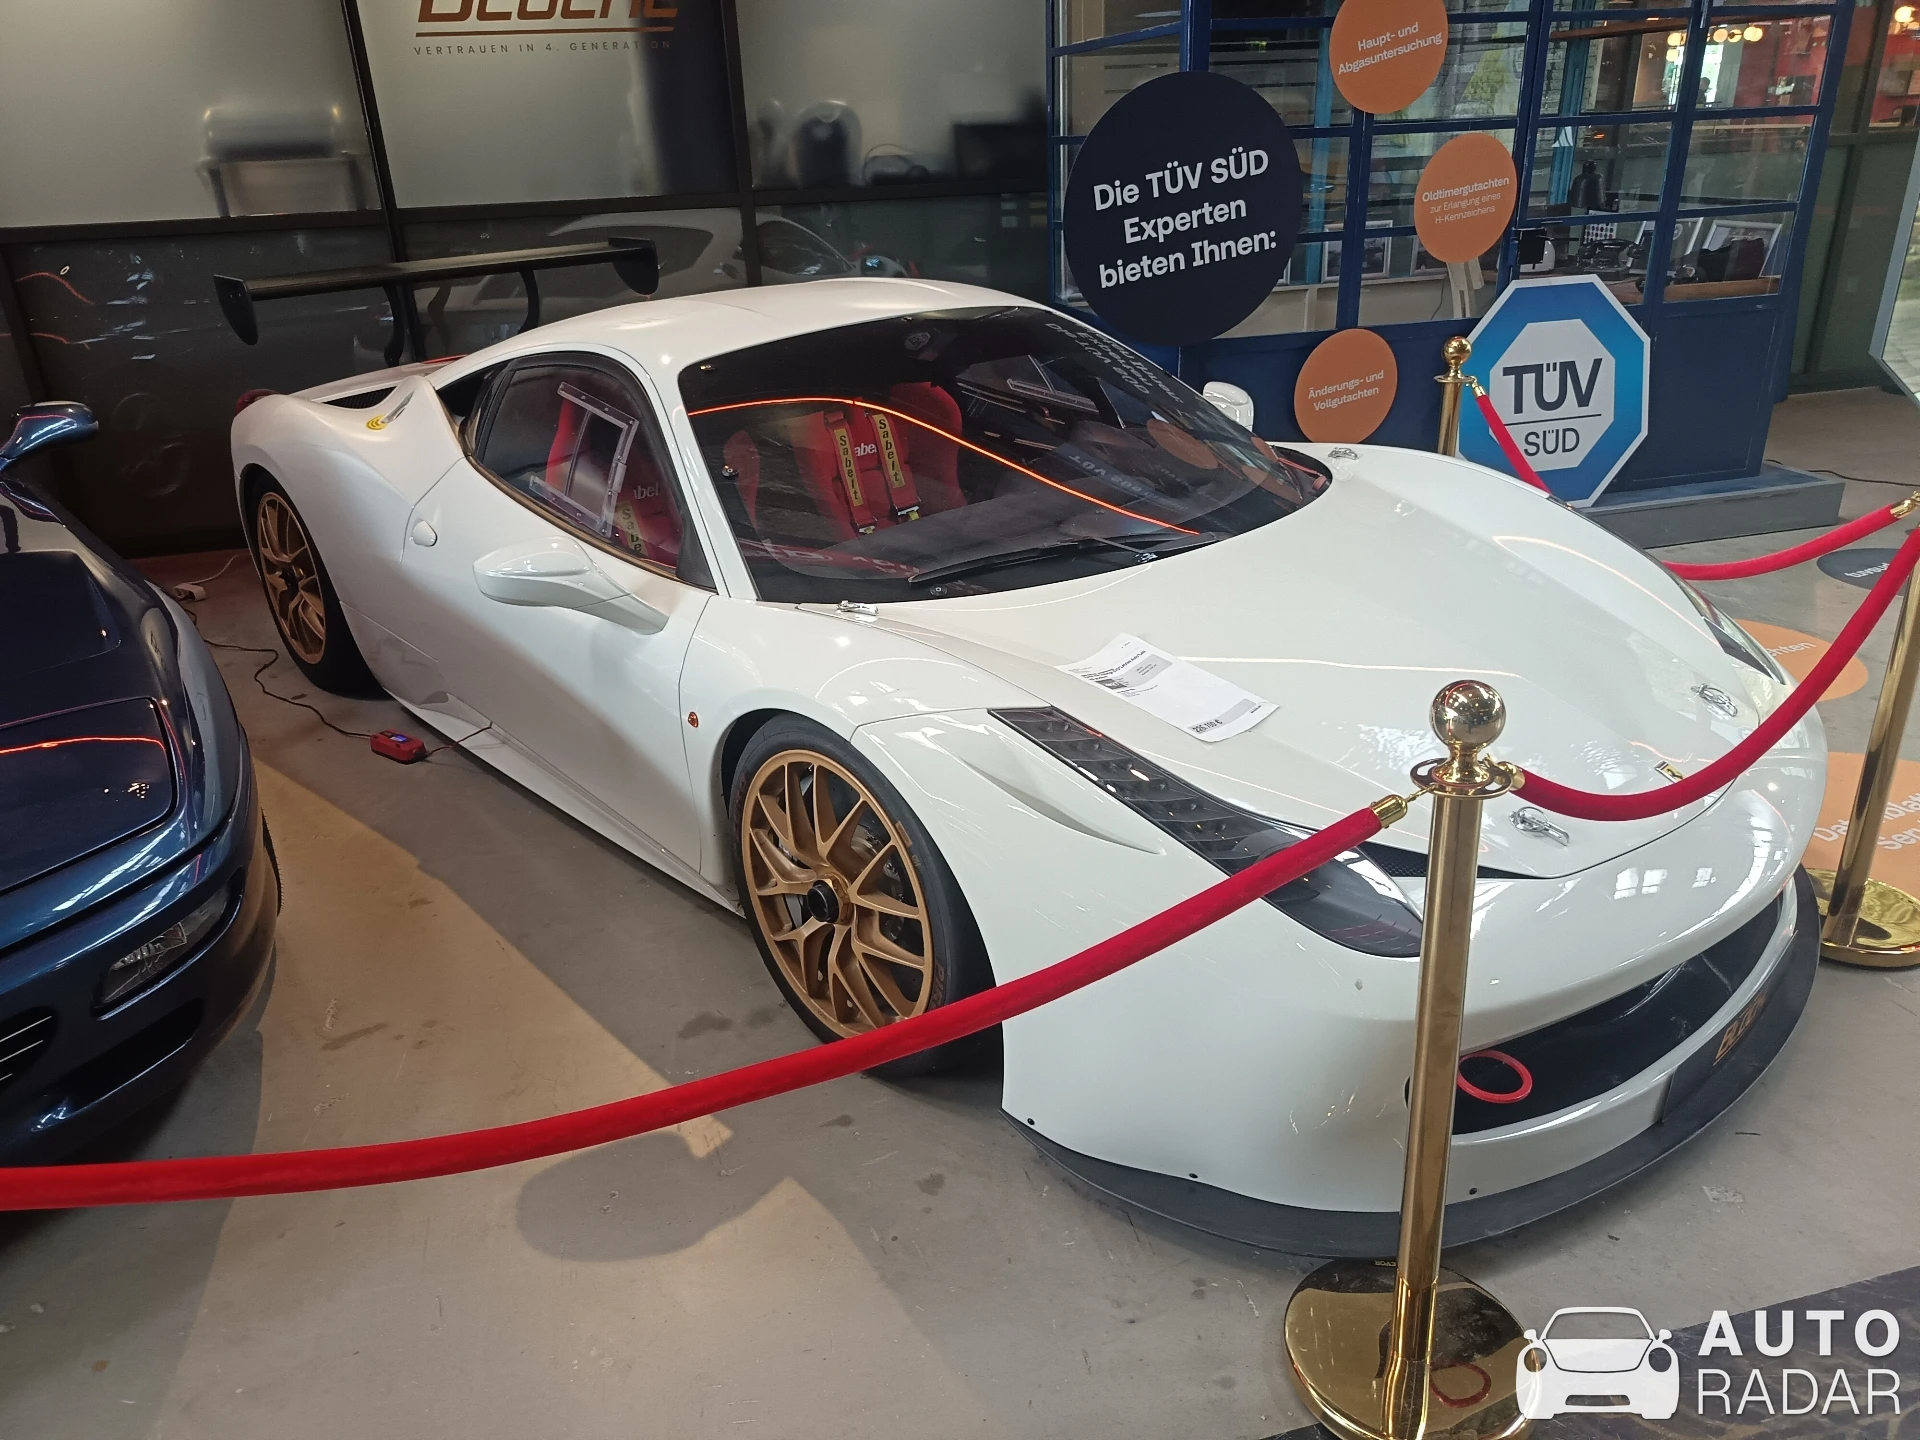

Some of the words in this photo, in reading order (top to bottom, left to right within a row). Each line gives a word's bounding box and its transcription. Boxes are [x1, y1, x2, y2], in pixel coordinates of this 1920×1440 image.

[413, 44, 508, 55] VERTRAUEN
[519, 43, 534, 52] IN
[545, 43, 559, 52] 4.
[569, 40, 670, 51] GENERATON
[1357, 32, 1396, 51] Haupt-
[1398, 22, 1419, 38] und
[1338, 32, 1443, 75] Abgasuntersuchung
[1093, 179, 1140, 211] Die
[1145, 160, 1203, 198] TÜV
[1210, 146, 1269, 184] SÜD
[1422, 176, 1510, 202] Oldtimergutachten
[1429, 203, 1442, 214] zur
[1443, 196, 1480, 212] Erlangung
[1481, 191, 1501, 203] eines
[1435, 205, 1496, 224] H-Kennzeichens
[1123, 199, 1247, 244] Experten
[1099, 251, 1185, 289] bieten
[1191, 230, 1277, 267] Ihnen:
[1307, 377, 1364, 399] Änderungs-
[1365, 369, 1384, 384] und
[1313, 385, 1380, 411] Vollgutachten
[1502, 357, 1603, 415] TÜV
[878, 418, 900, 482] Sabelt
[1523, 426, 1580, 458] SÜD
[839, 435, 859, 500] Sabelt
